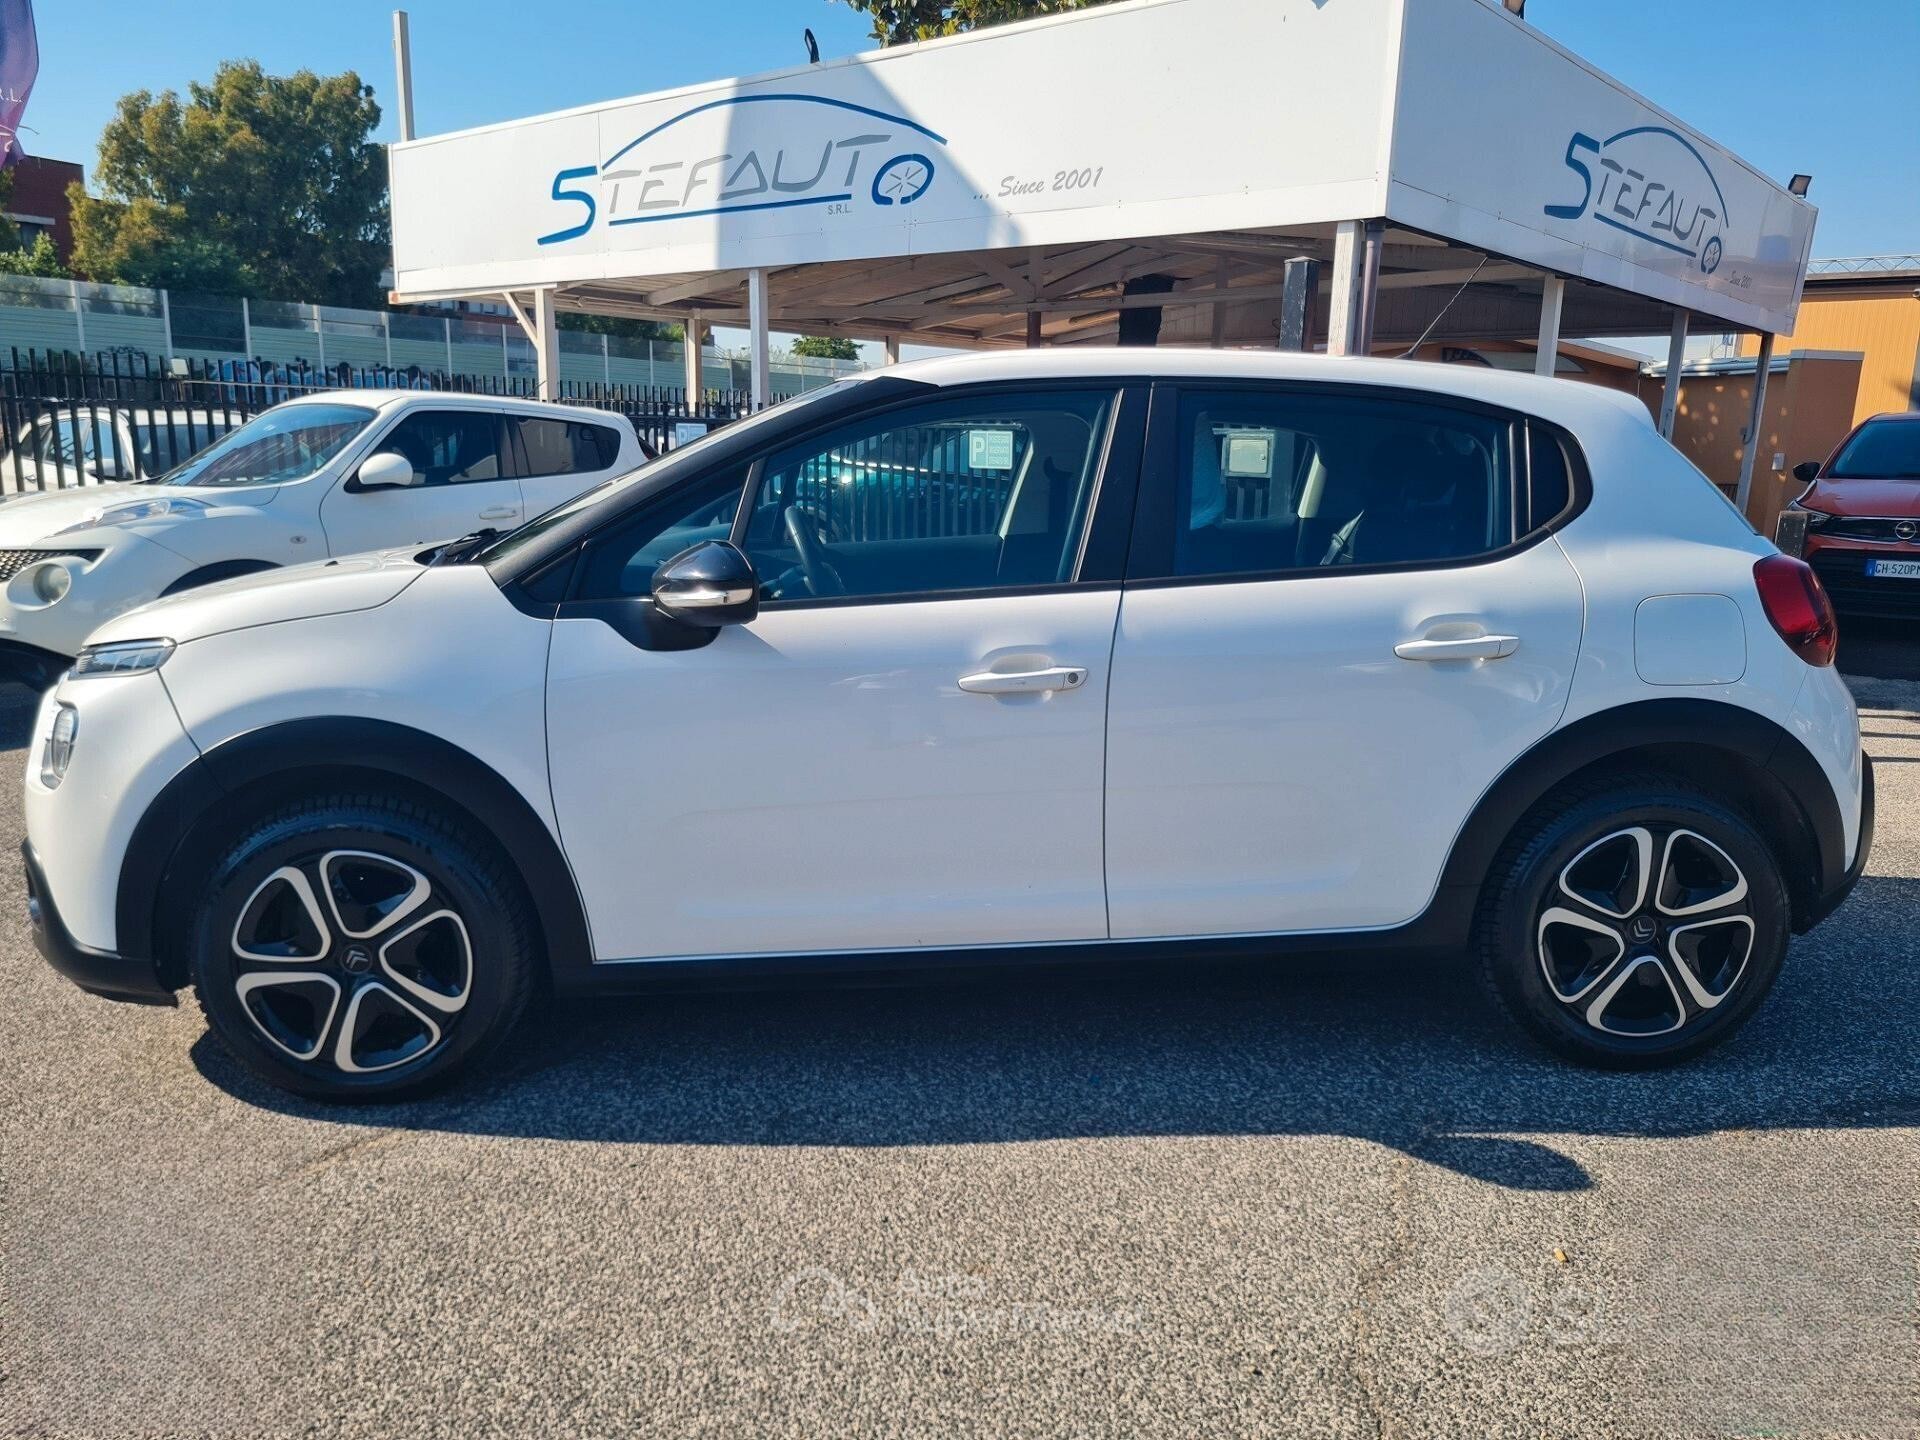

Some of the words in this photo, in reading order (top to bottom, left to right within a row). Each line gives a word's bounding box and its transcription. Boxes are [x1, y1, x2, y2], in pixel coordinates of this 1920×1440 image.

[537, 134, 934, 246] STEFAUTO
[998, 175, 1045, 198] Since
[1052, 166, 1104, 192] 2001
[1543, 131, 1722, 275] STEFAUTO
